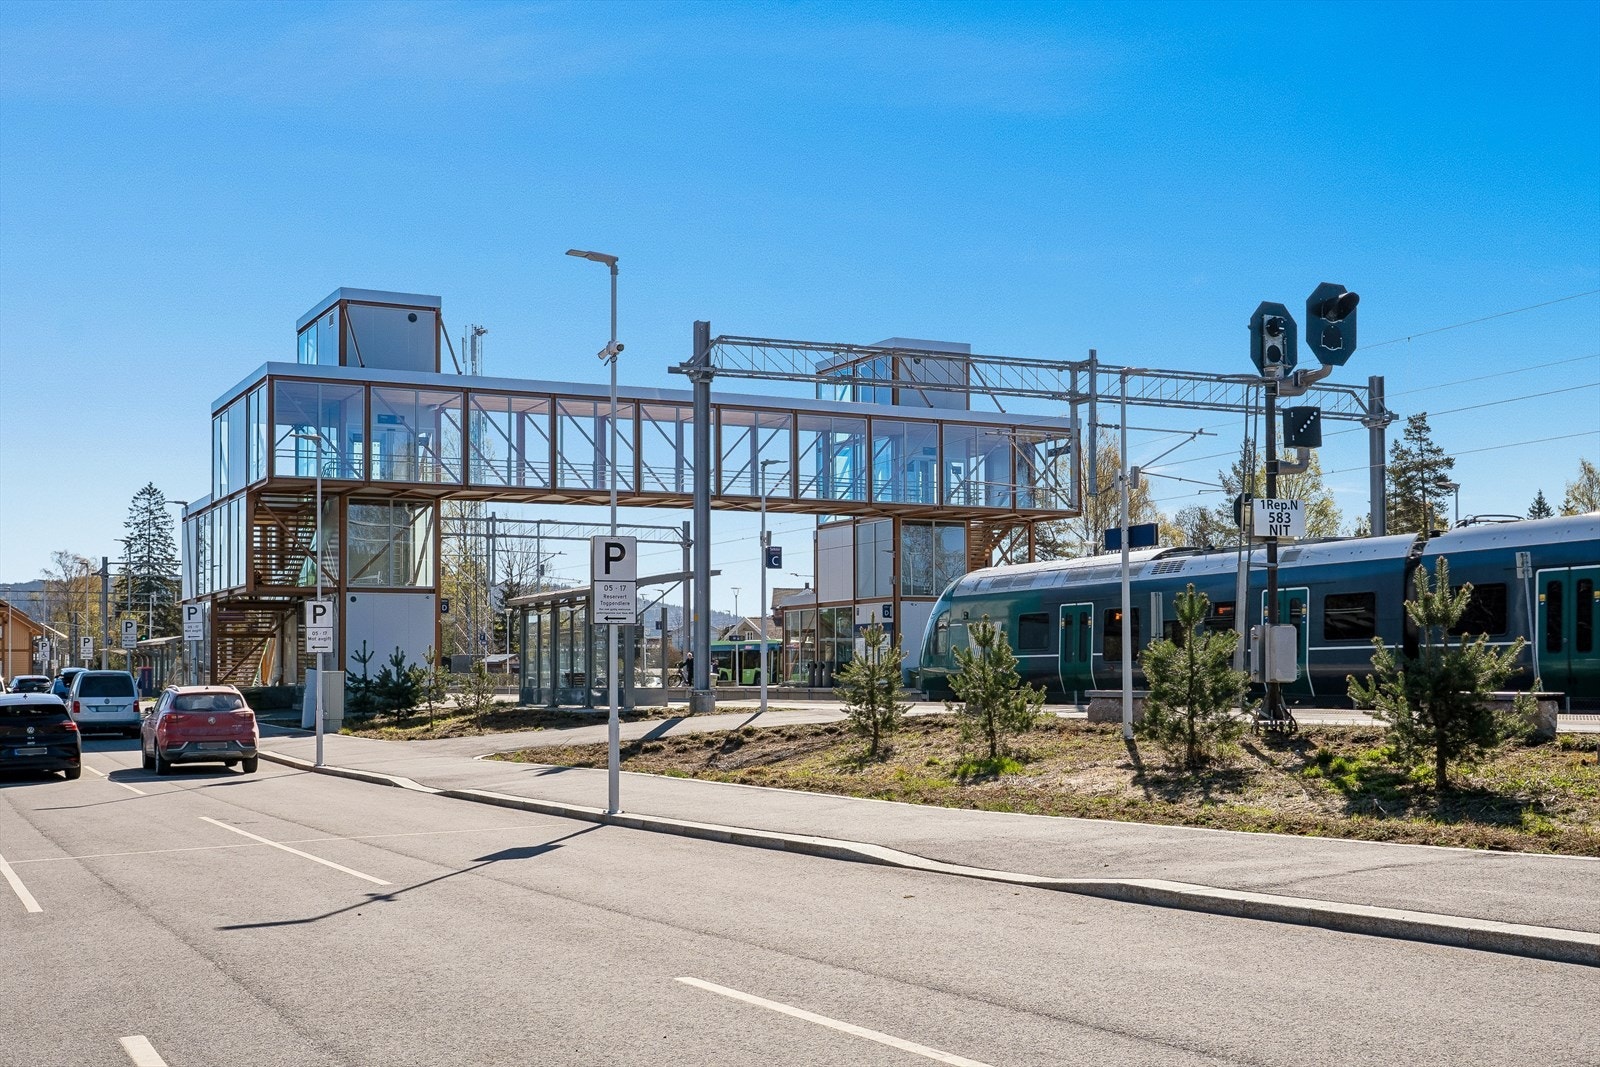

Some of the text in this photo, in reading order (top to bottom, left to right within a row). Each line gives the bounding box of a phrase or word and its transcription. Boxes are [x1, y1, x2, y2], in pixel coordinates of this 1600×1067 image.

[1260, 500, 1298, 512] 1Rep.N
[1269, 512, 1291, 523] 583
[1269, 524, 1290, 536] NIT
[604, 542, 626, 575] P
[771, 556, 779, 566] C
[187, 607, 197, 620] P
[313, 604, 327, 624] P
[125, 622, 133, 632] P
[83, 637, 90, 646] P
